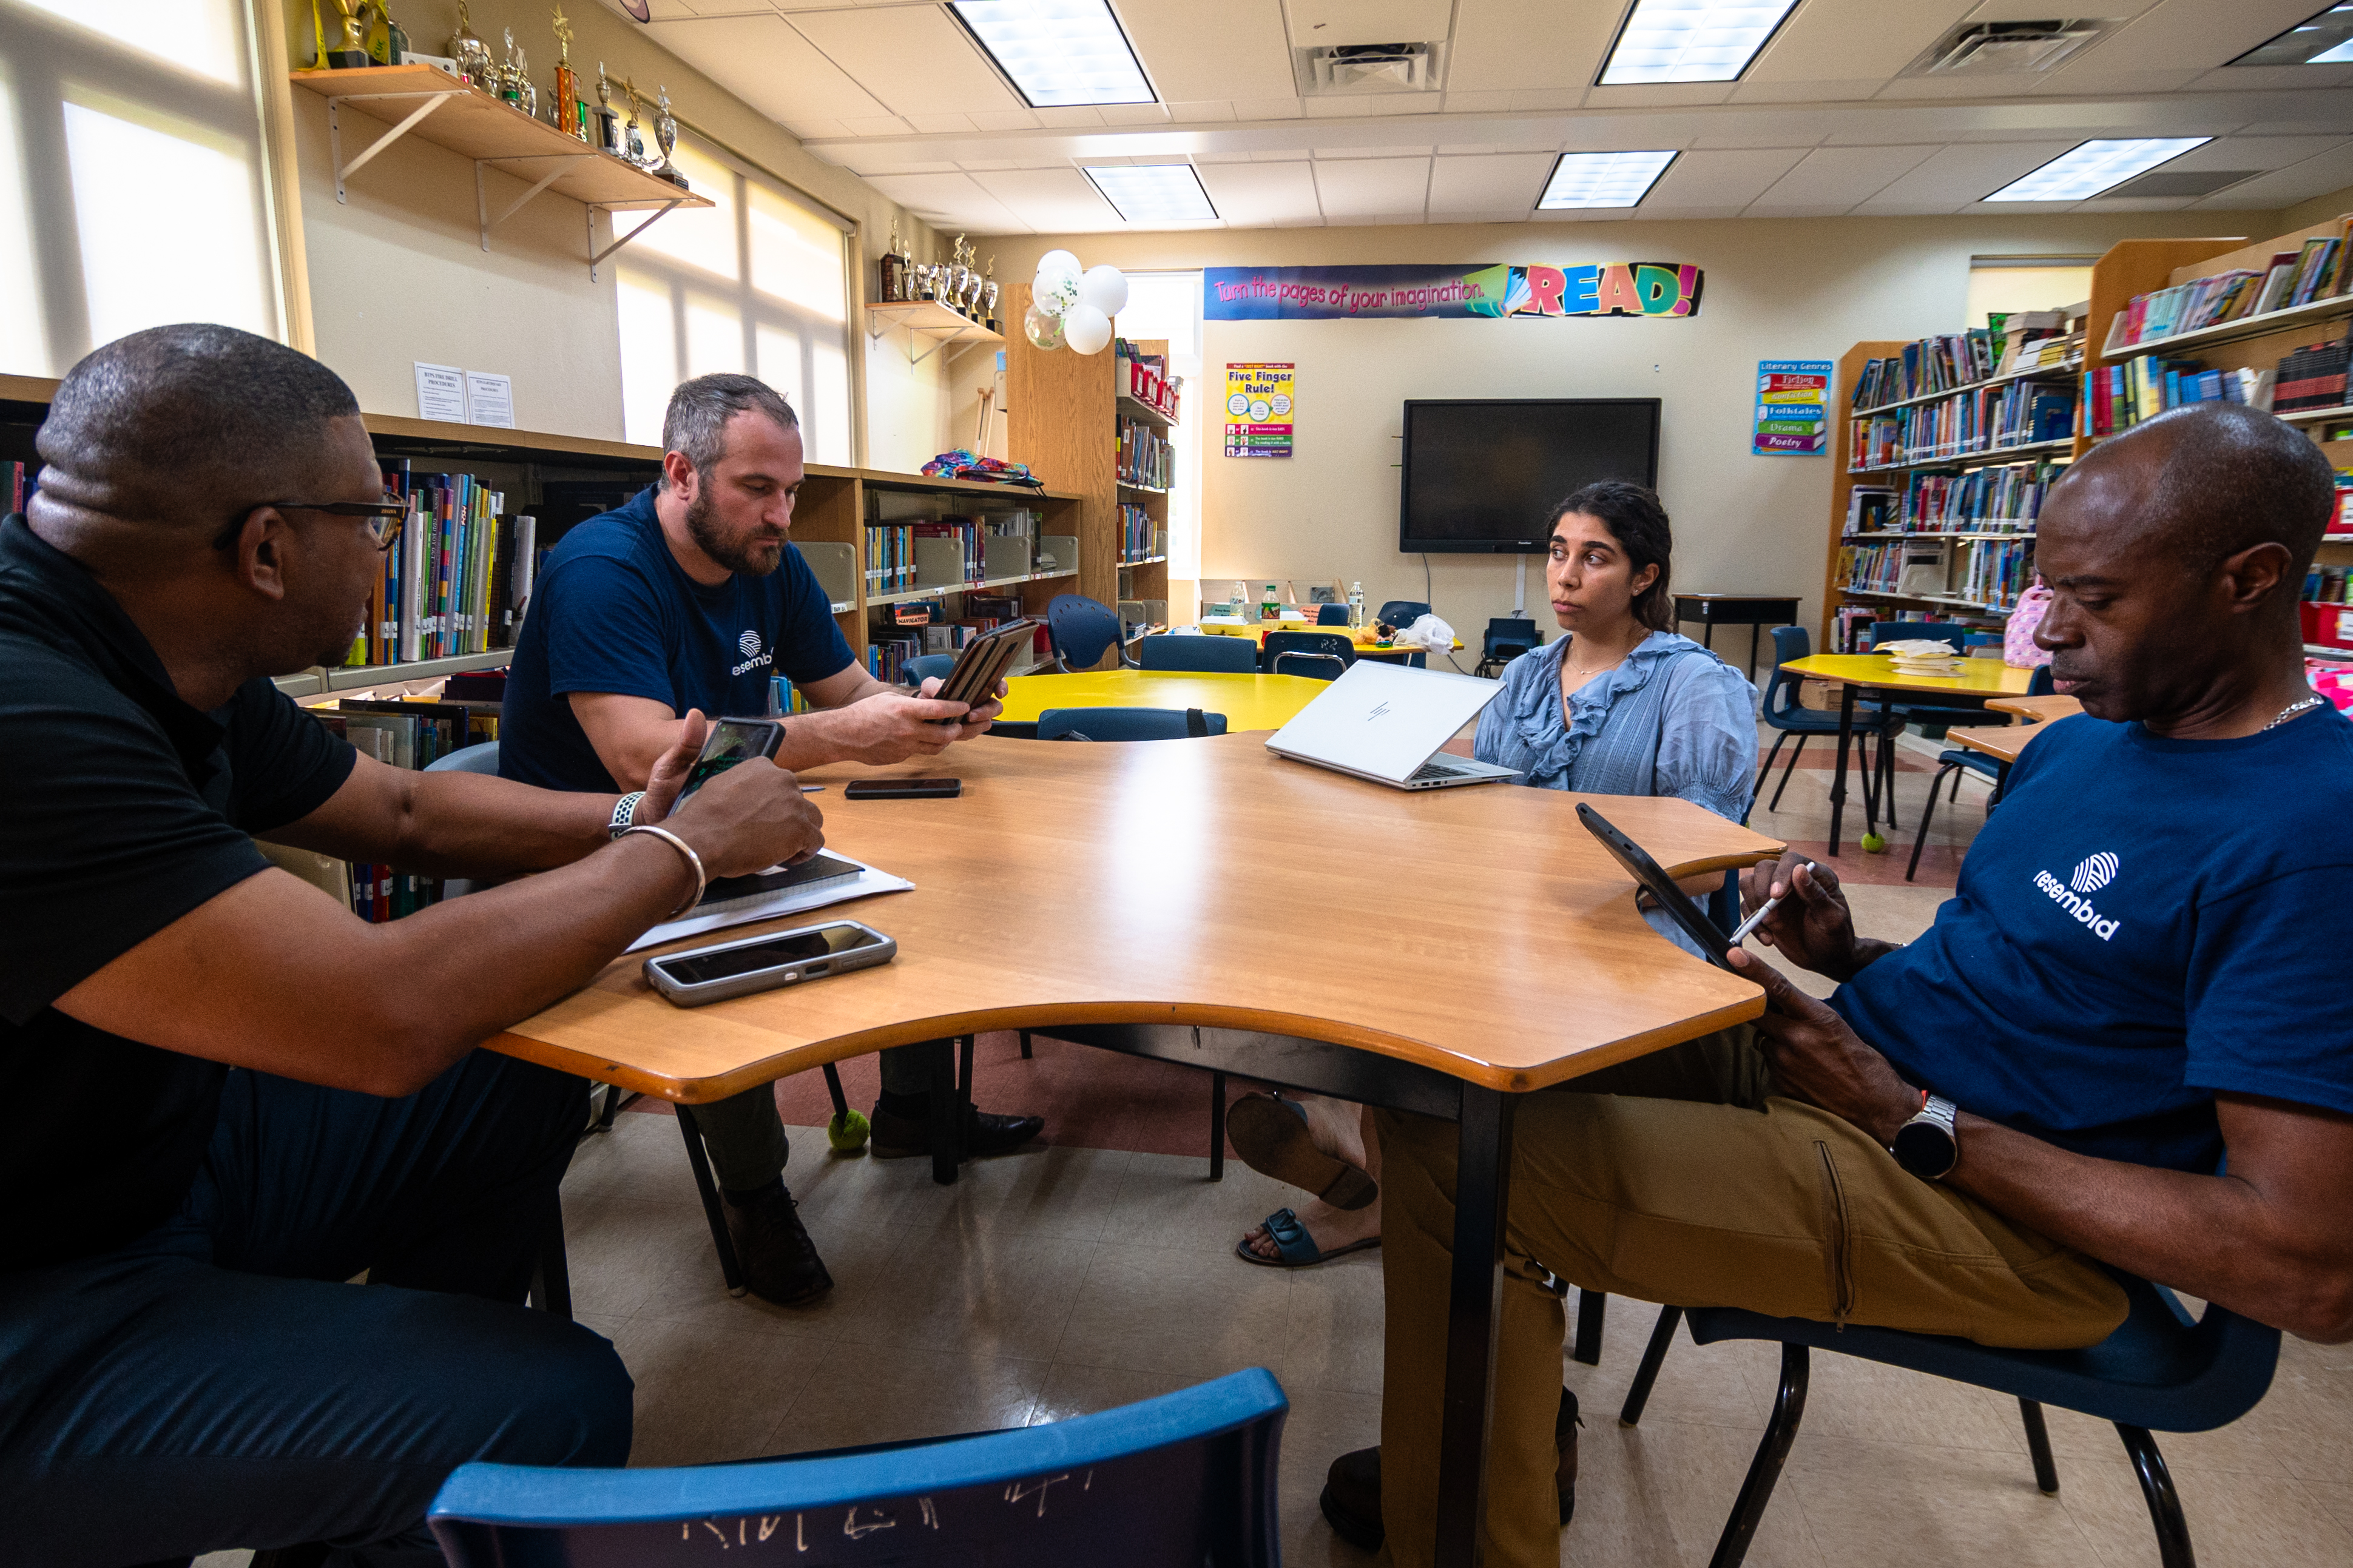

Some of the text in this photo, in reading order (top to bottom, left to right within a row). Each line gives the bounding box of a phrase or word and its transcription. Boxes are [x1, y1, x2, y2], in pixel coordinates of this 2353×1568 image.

[1214, 275, 1484, 313] Turn the pages of your imagination.
[1521, 264, 1698, 317] READ!
[1761, 362, 1797, 373] Literary
[1229, 371, 1292, 383] Five Finger
[1783, 375, 1814, 385] Fiction
[1245, 384, 1274, 393] Rule!
[1770, 423, 1803, 432] Drama
[1769, 437, 1802, 448] Poetry
[2033, 870, 2121, 941] resembid
